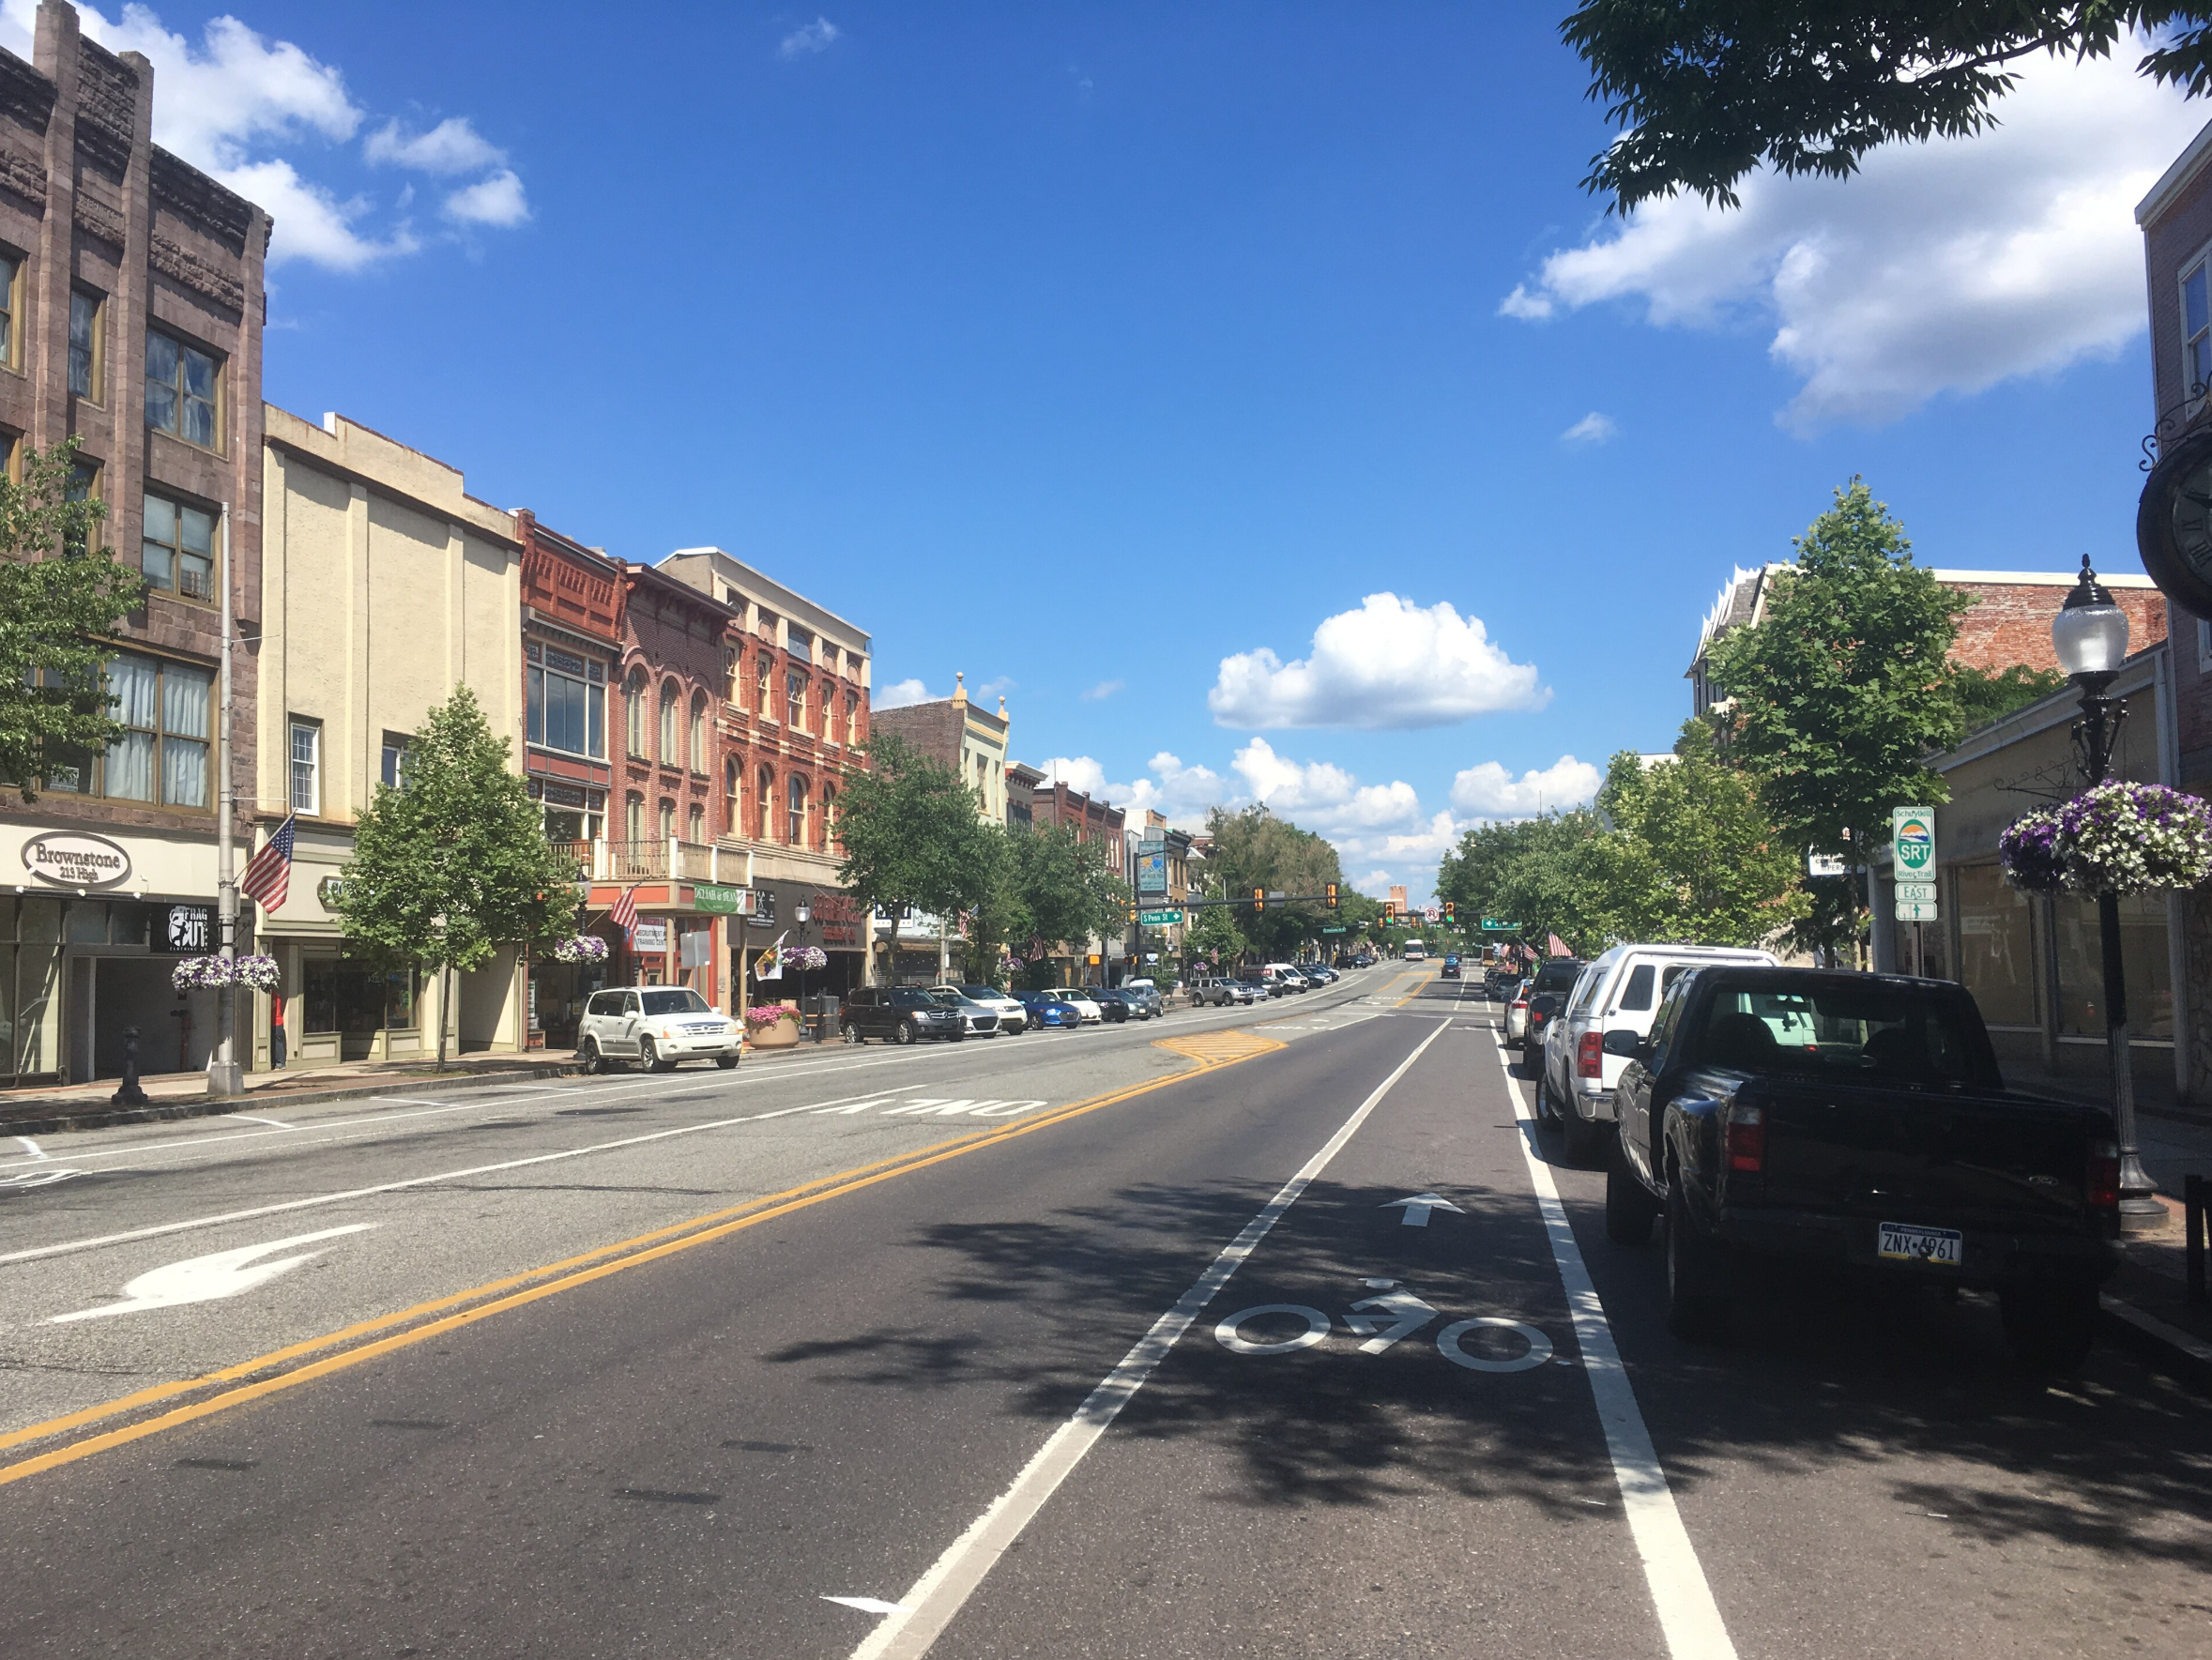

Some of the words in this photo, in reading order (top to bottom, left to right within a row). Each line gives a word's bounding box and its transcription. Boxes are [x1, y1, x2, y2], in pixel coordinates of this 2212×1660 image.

[35, 842, 121, 869] Brownstone
[1900, 845, 1930, 860] SRT
[59, 866, 75, 879] 213
[75, 867, 99, 883] High
[1904, 886, 1928, 898] EAST
[184, 906, 207, 921] FRAG
[1143, 914, 1148, 922] S
[1148, 913, 1161, 921] Penn
[809, 1099, 1048, 1117] ONLY
[1899, 1226, 1942, 1236] PENNSYLVANIA
